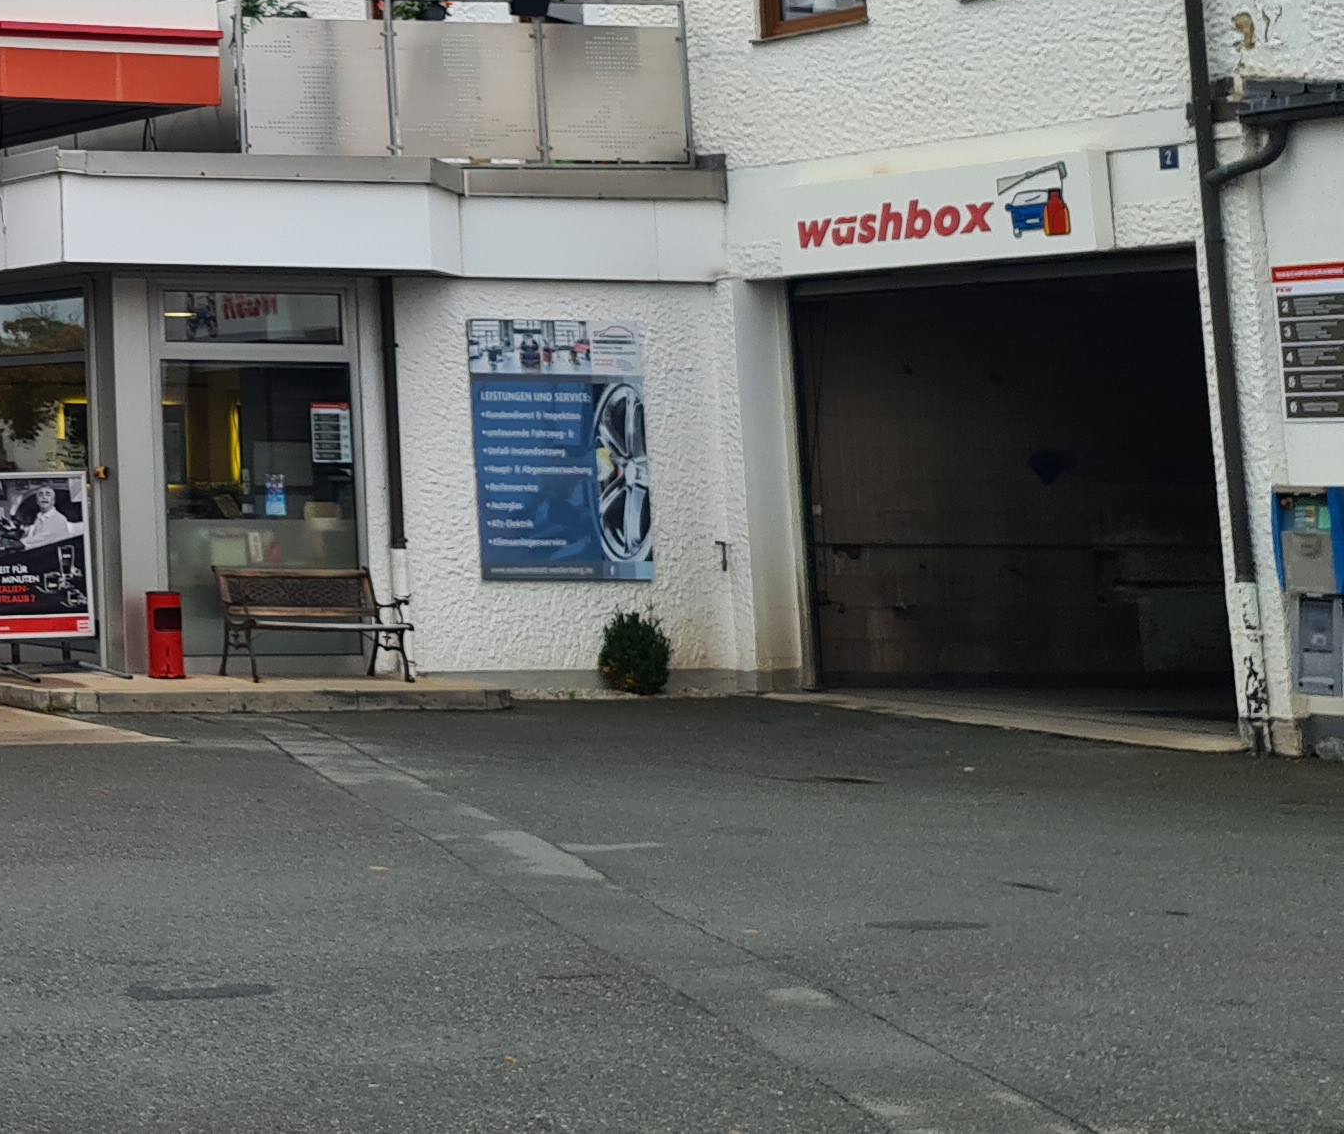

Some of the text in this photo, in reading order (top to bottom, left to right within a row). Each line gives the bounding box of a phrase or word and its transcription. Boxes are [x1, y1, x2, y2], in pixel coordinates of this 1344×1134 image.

[797, 199, 994, 249] washbox
[480, 391, 532, 401] LEISTUNGEN
[533, 392, 552, 402] UND
[12, 563, 29, 574] FÜR
[2, 575, 40, 584] MINUTEN
